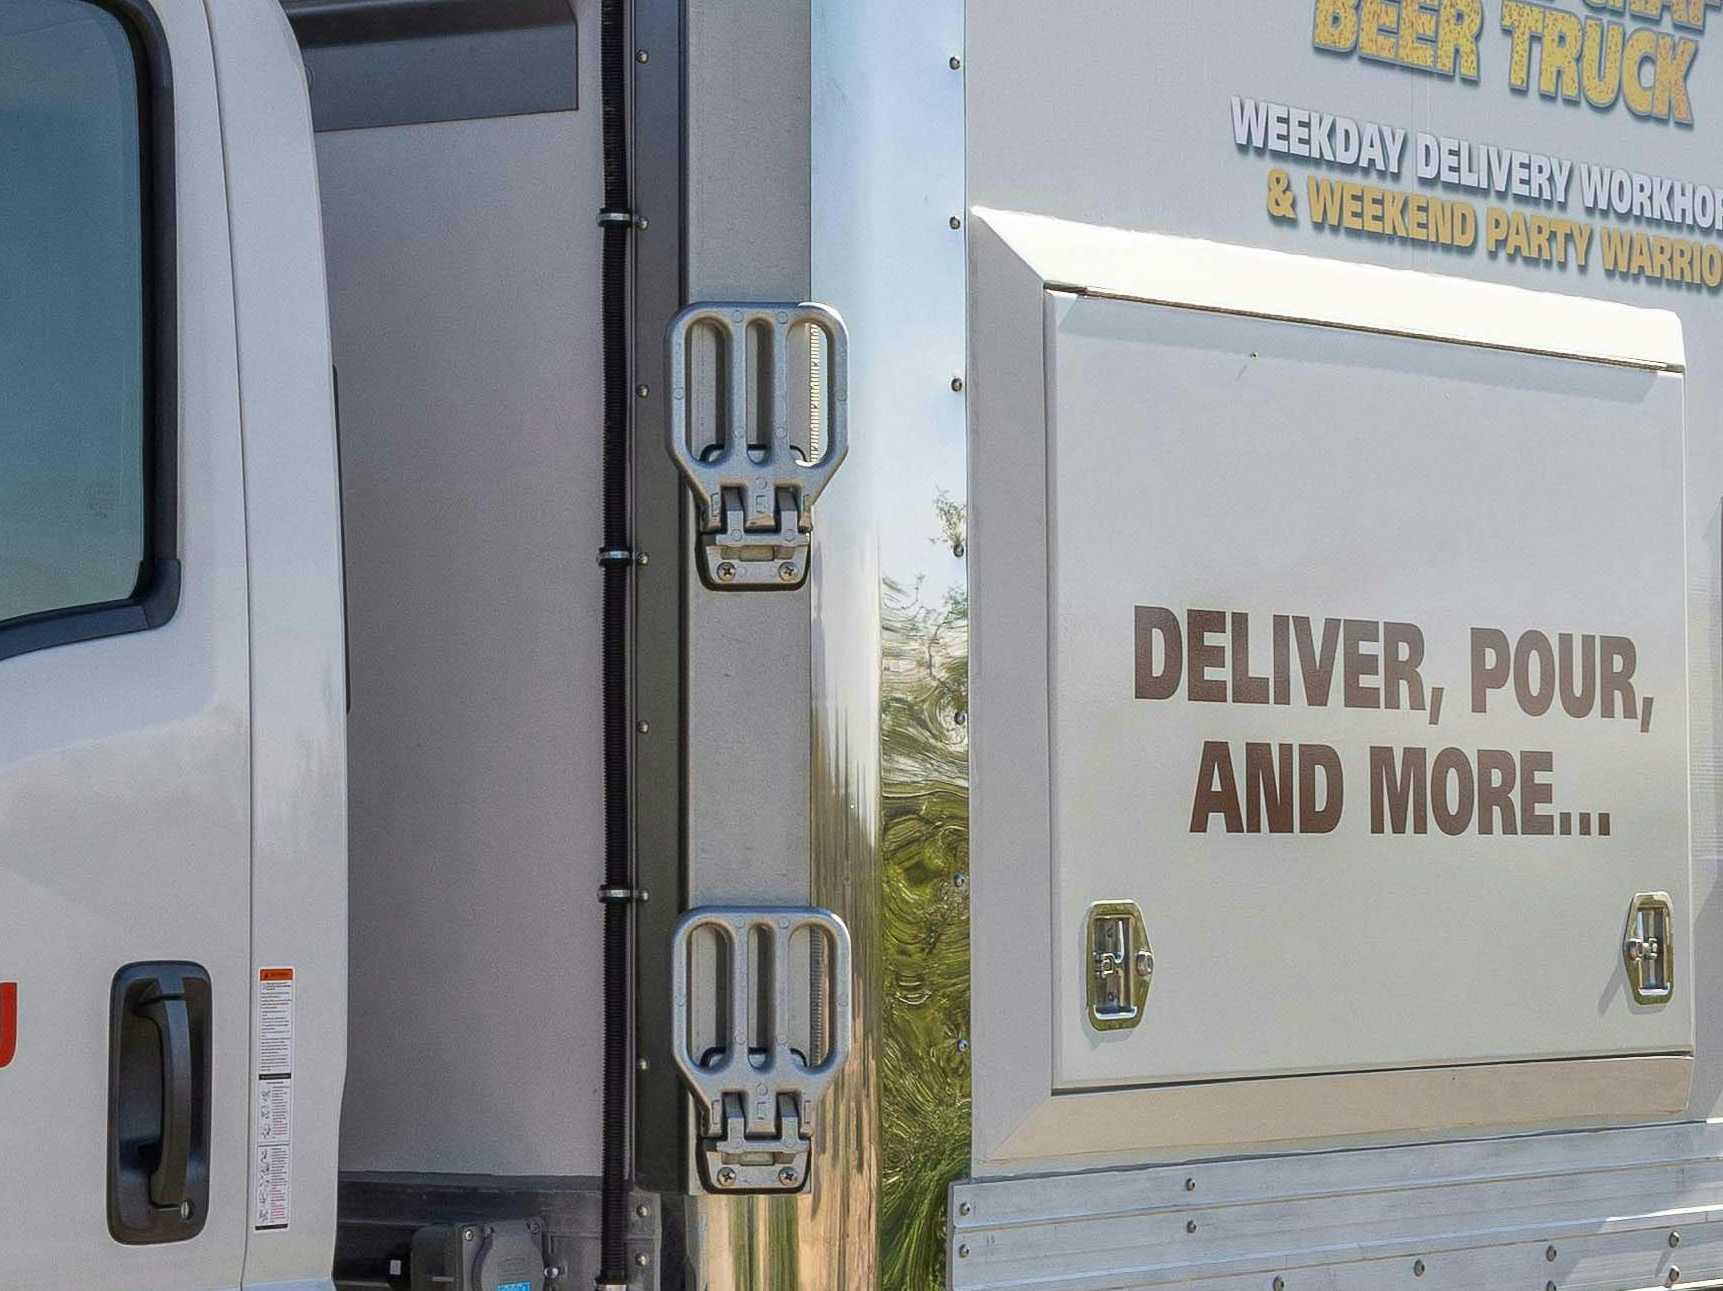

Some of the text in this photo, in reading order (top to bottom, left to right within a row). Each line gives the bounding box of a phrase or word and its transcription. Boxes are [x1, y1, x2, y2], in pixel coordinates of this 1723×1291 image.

[1231, 97, 1407, 174] WEEKDAY
[1415, 132, 1573, 208] DELIVERY
[1266, 168, 1297, 219] &
[1307, 174, 1476, 250] WEEKEND
[1486, 207, 1592, 271] PARTY
[1133, 604, 1655, 734] DELIVER, POUR,
[1188, 740, 1612, 837] AND MORE...
